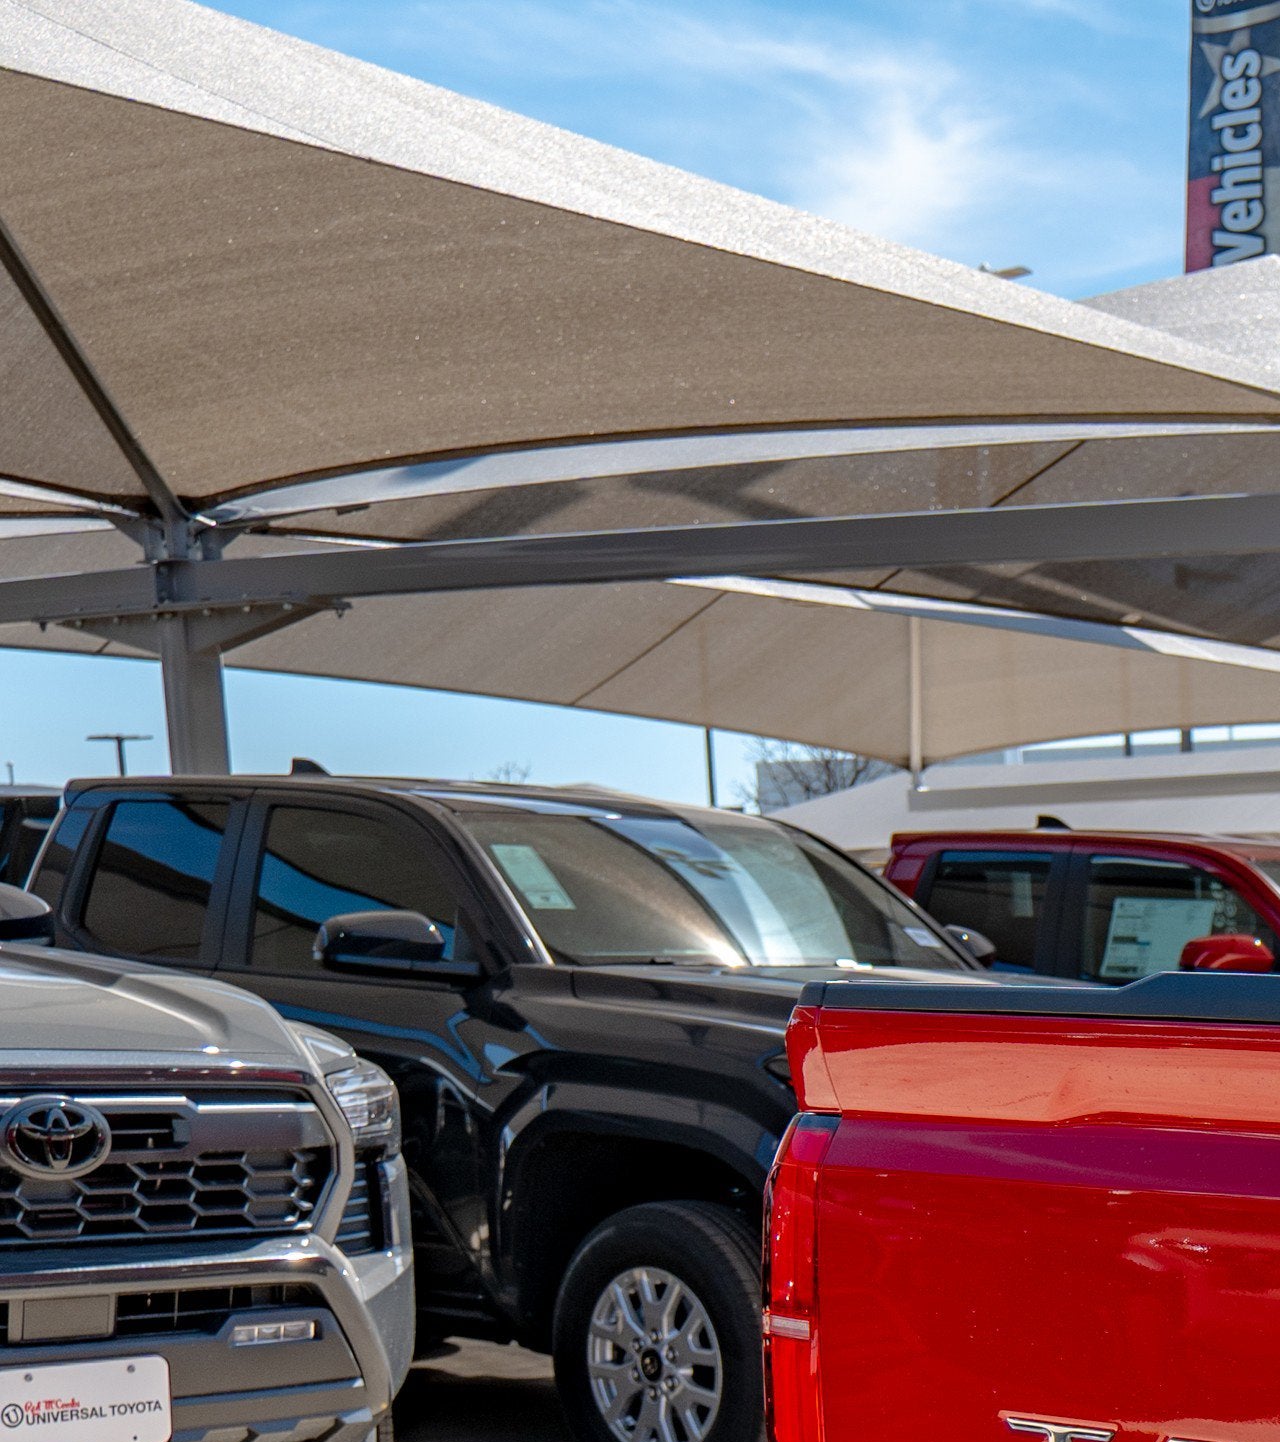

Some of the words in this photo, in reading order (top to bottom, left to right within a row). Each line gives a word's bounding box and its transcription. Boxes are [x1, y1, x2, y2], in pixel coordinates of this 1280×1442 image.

[1210, 48, 1265, 268] Vehicles
[25, 1406, 107, 1426] UNIVERSAL
[109, 1400, 163, 1417] TOYOTA
